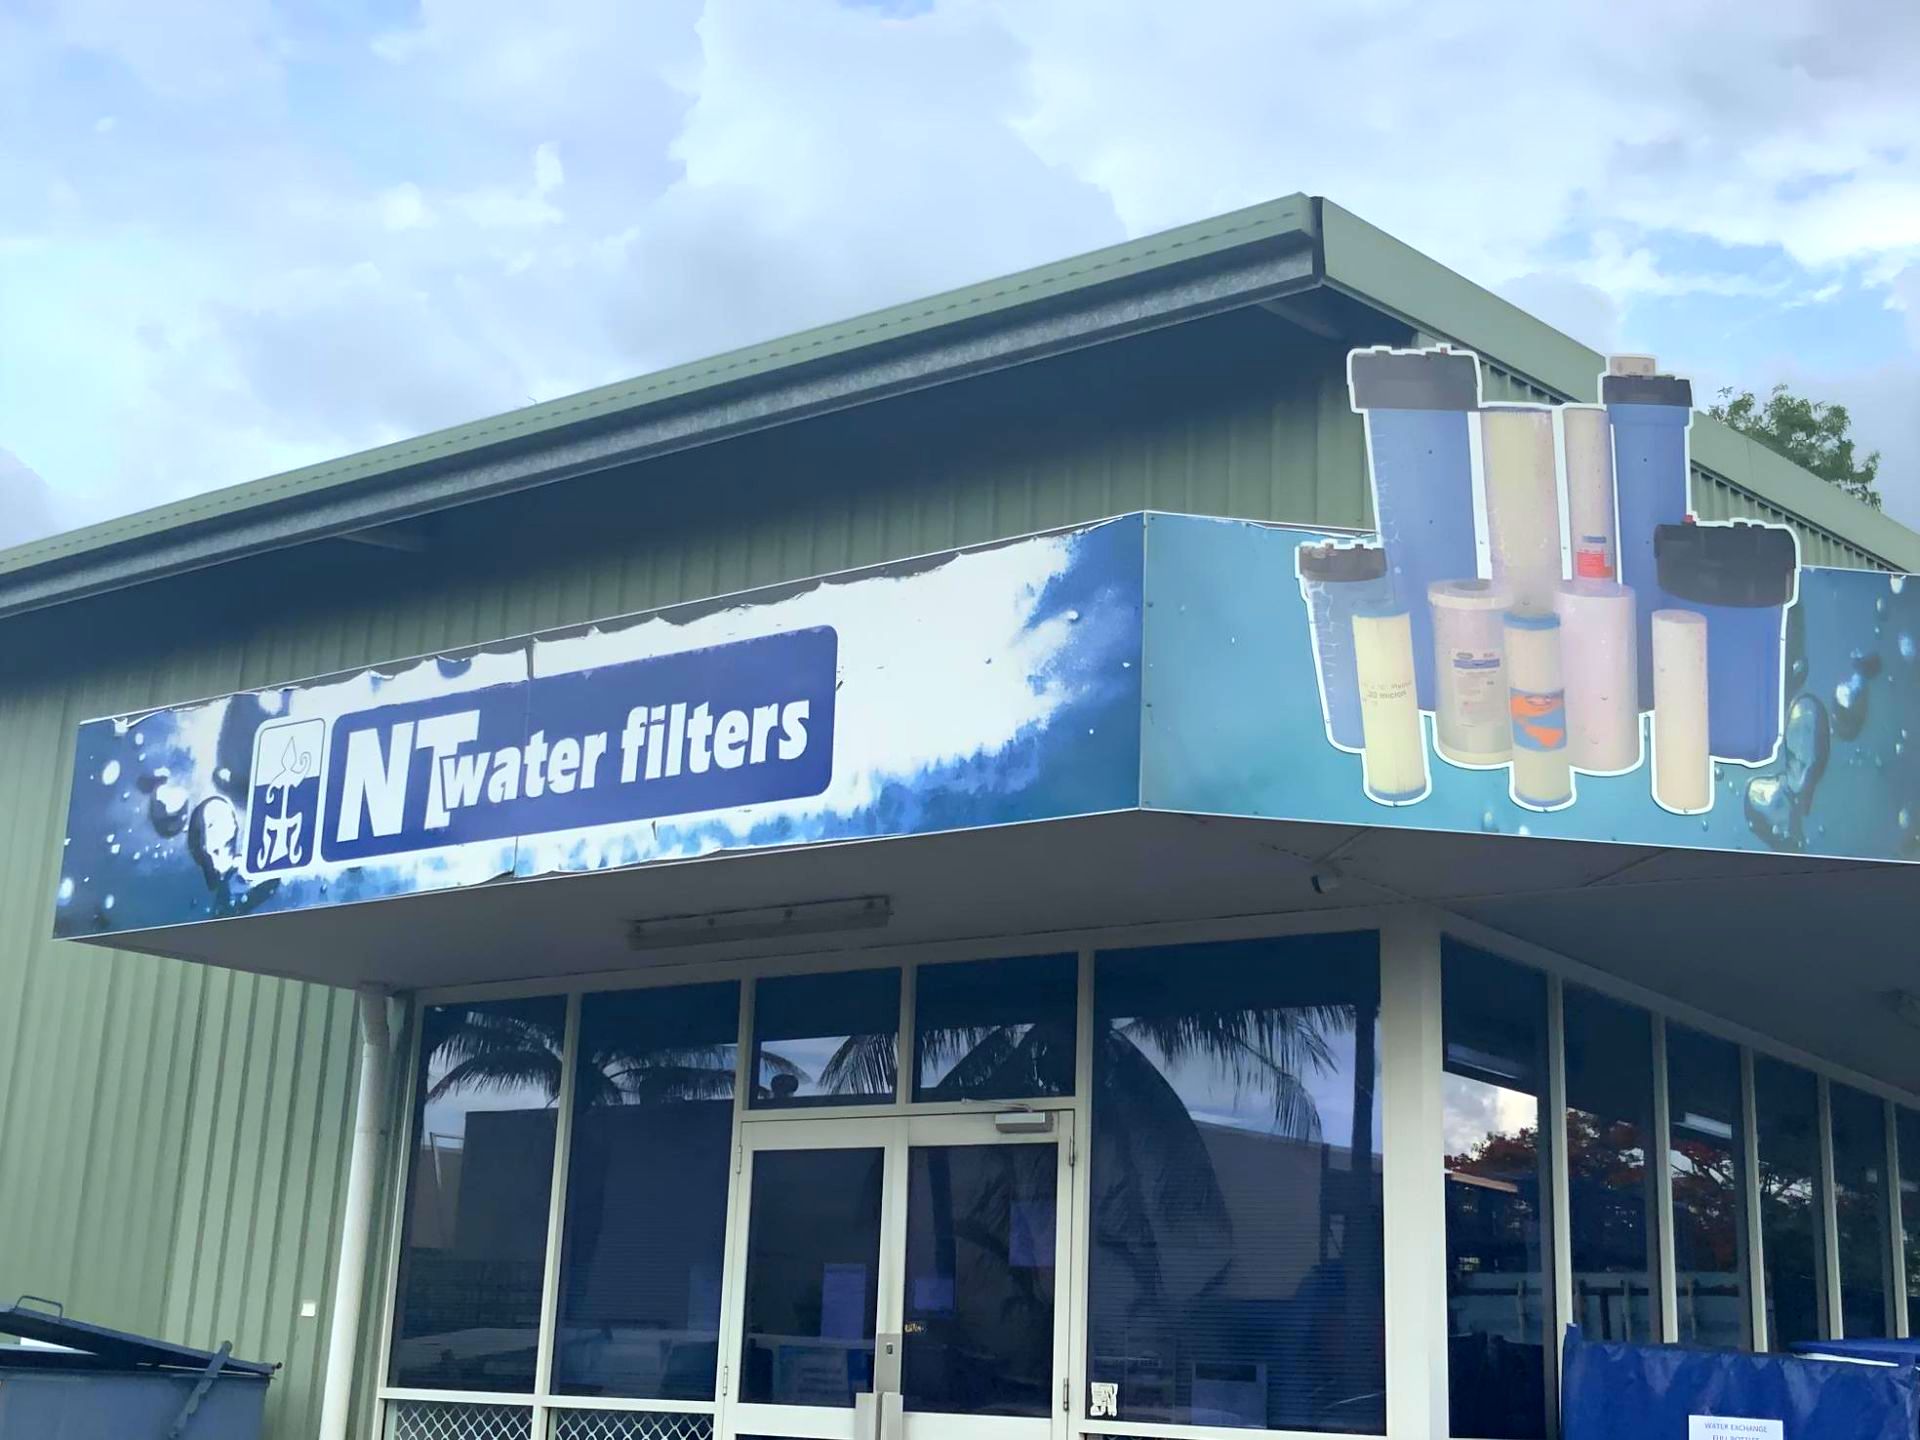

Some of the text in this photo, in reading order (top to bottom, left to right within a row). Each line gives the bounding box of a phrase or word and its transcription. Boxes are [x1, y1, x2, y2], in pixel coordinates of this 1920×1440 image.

[336, 700, 810, 843] NT water filters
[1704, 1422, 1768, 1433] WATER EXCHANGE
